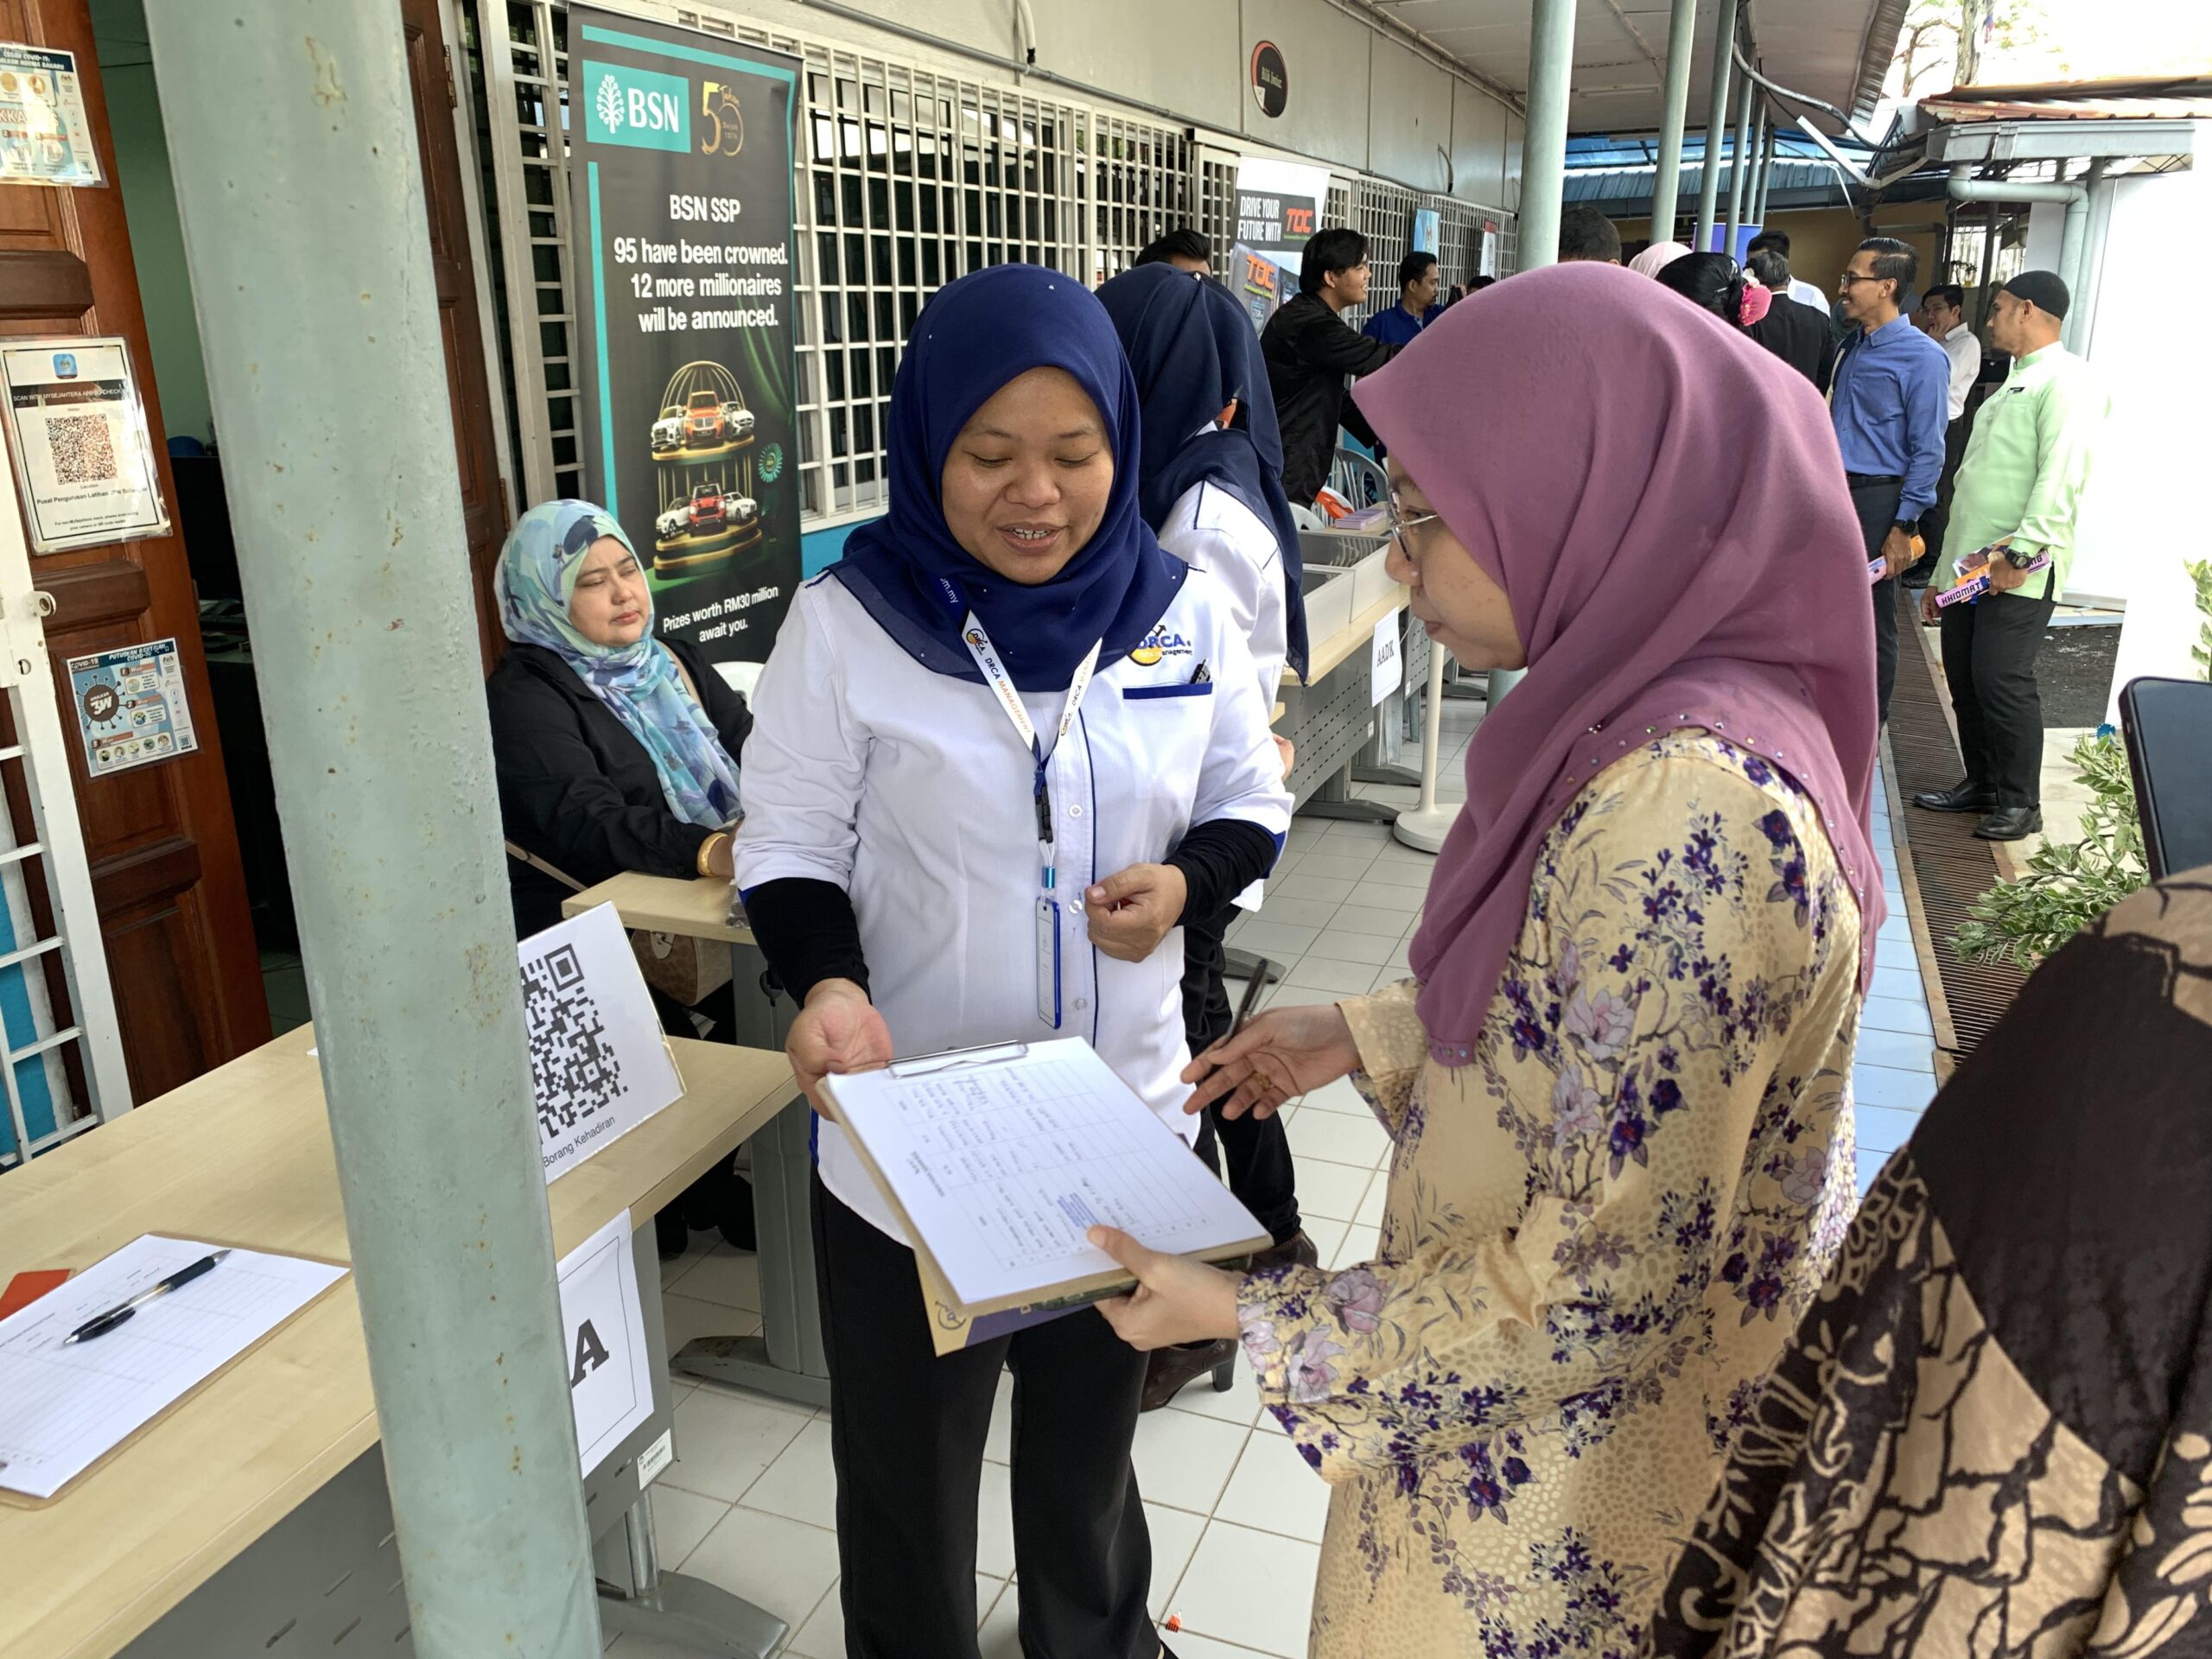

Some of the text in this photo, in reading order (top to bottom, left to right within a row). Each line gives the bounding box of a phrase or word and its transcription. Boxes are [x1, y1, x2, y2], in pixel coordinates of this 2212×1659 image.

[627, 87, 679, 133] BSN
[670, 194, 741, 223] BSN SSP
[1239, 195, 1280, 219] DRIVE YOUR
[1286, 207, 1313, 233] TOC
[1236, 219, 1281, 242] FUTURE WITH
[613, 237, 788, 264] 95 have been crowned.
[631, 272, 782, 298] 12 more millionaires
[1247, 253, 1275, 291] TOC
[638, 303, 779, 333] will be announced.
[54, 493, 86, 504] Pengurusan
[1942, 582, 1980, 605] KHIDMAT
[663, 586, 779, 633] Prizes worth RM30 million
[699, 619, 748, 643] await you.
[1376, 639, 1395, 668] AADK
[985, 658, 1032, 734] DRCA MANAGEMENT
[1071, 684, 1083, 707] DRCA
[543, 1116, 616, 1167] Borang Kehadiran
